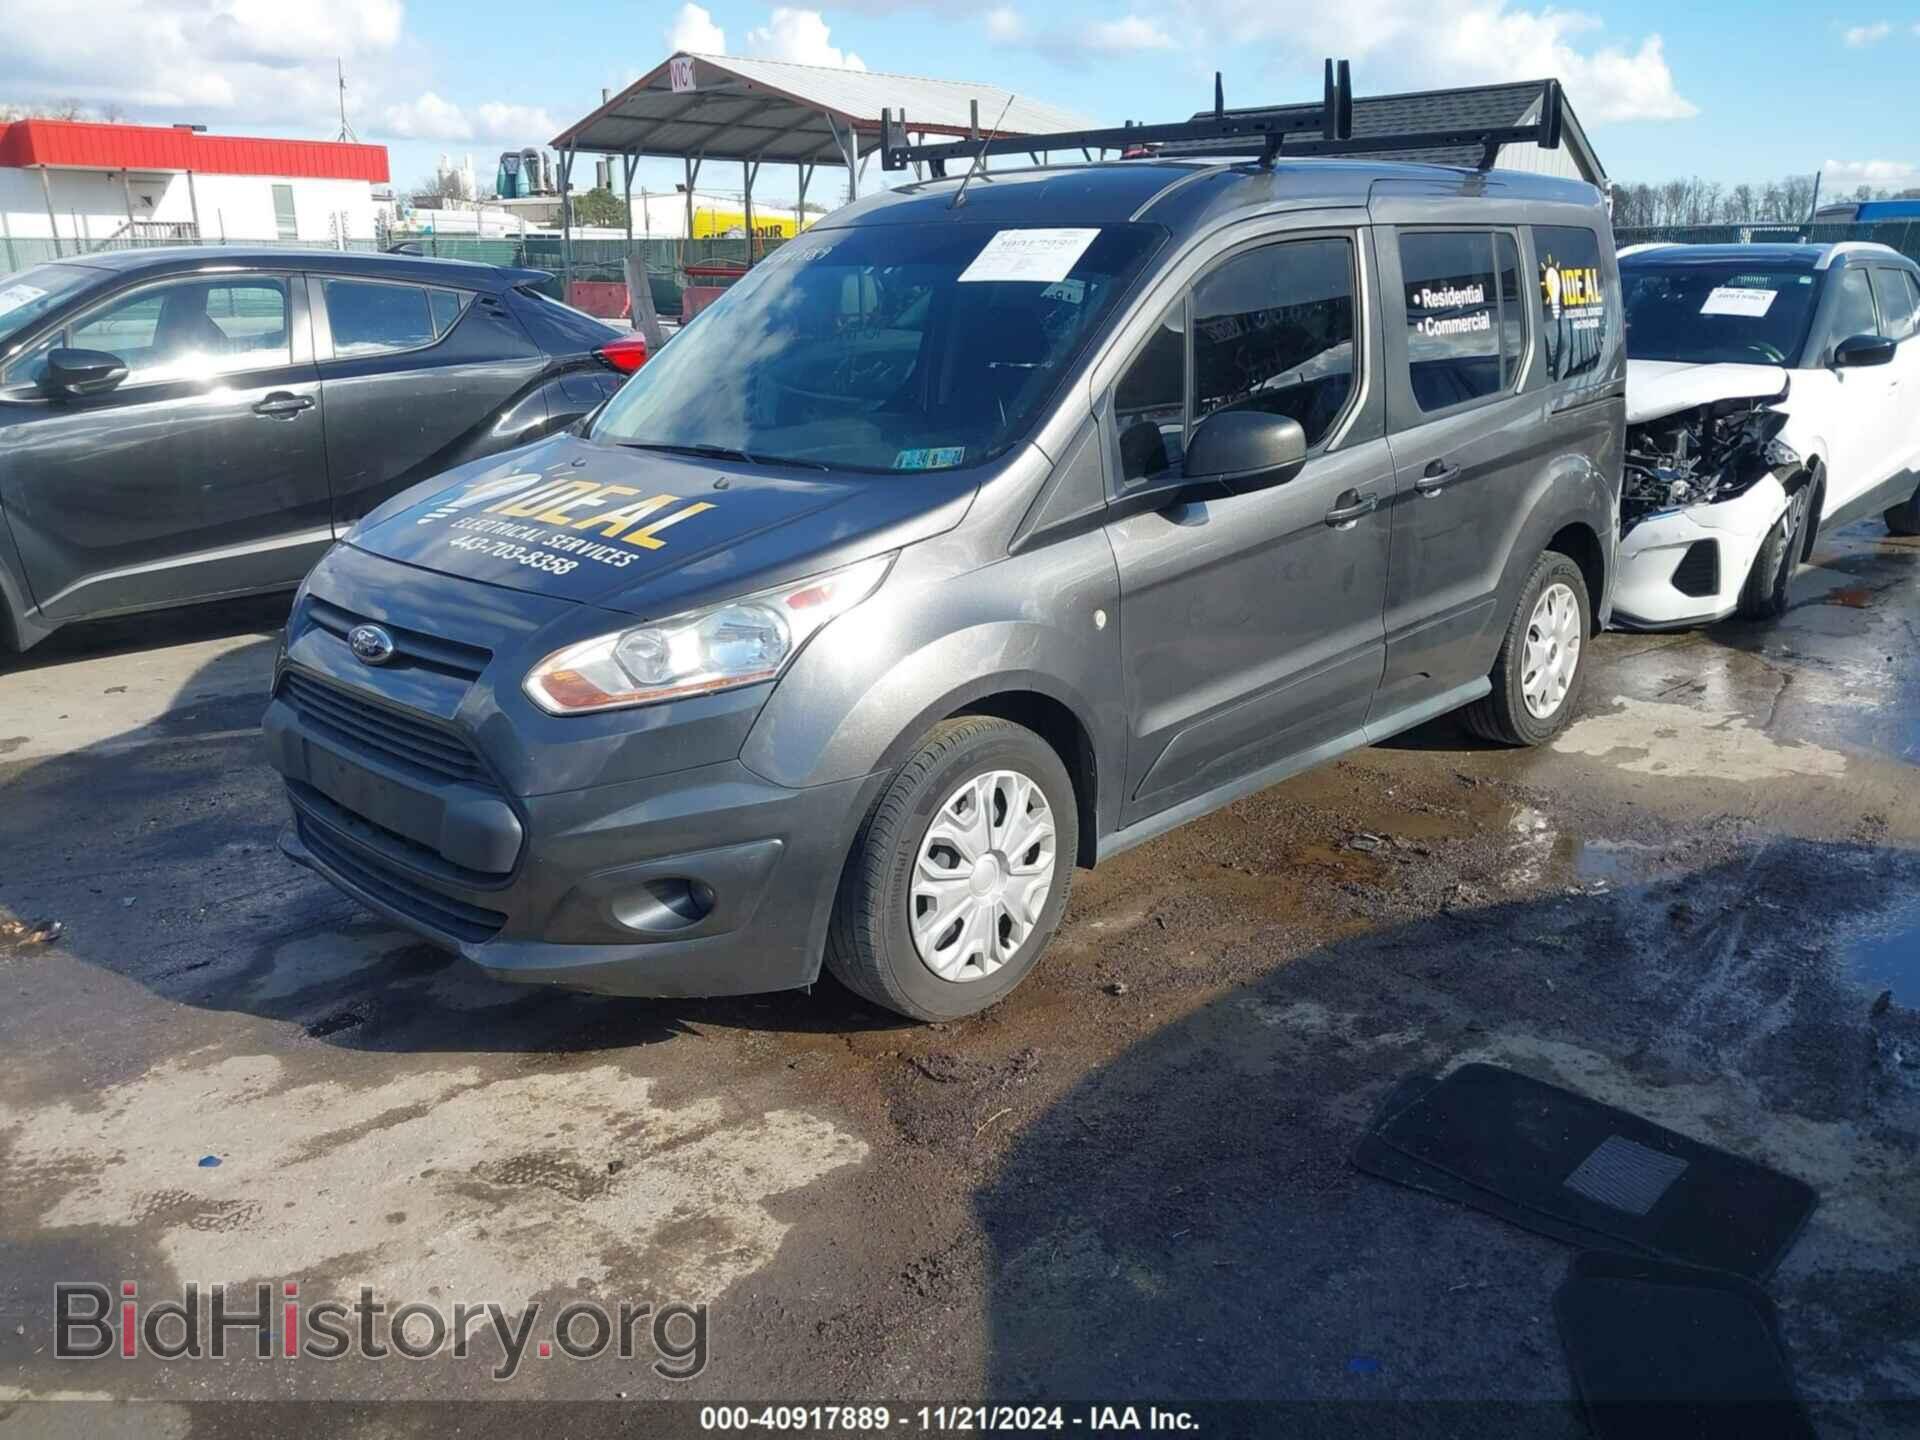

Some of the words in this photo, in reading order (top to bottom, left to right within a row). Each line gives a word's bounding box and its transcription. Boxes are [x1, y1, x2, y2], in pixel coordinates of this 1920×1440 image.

[1421, 283, 1485, 309] Residential
[1561, 268, 1603, 305] IDEAL
[1425, 310, 1490, 337] Commercial
[482, 478, 718, 550] IDEAL
[449, 534, 580, 576] 443-703-8358
[450, 516, 546, 543] ELECTRICAL
[542, 533, 640, 568] SERVICES
